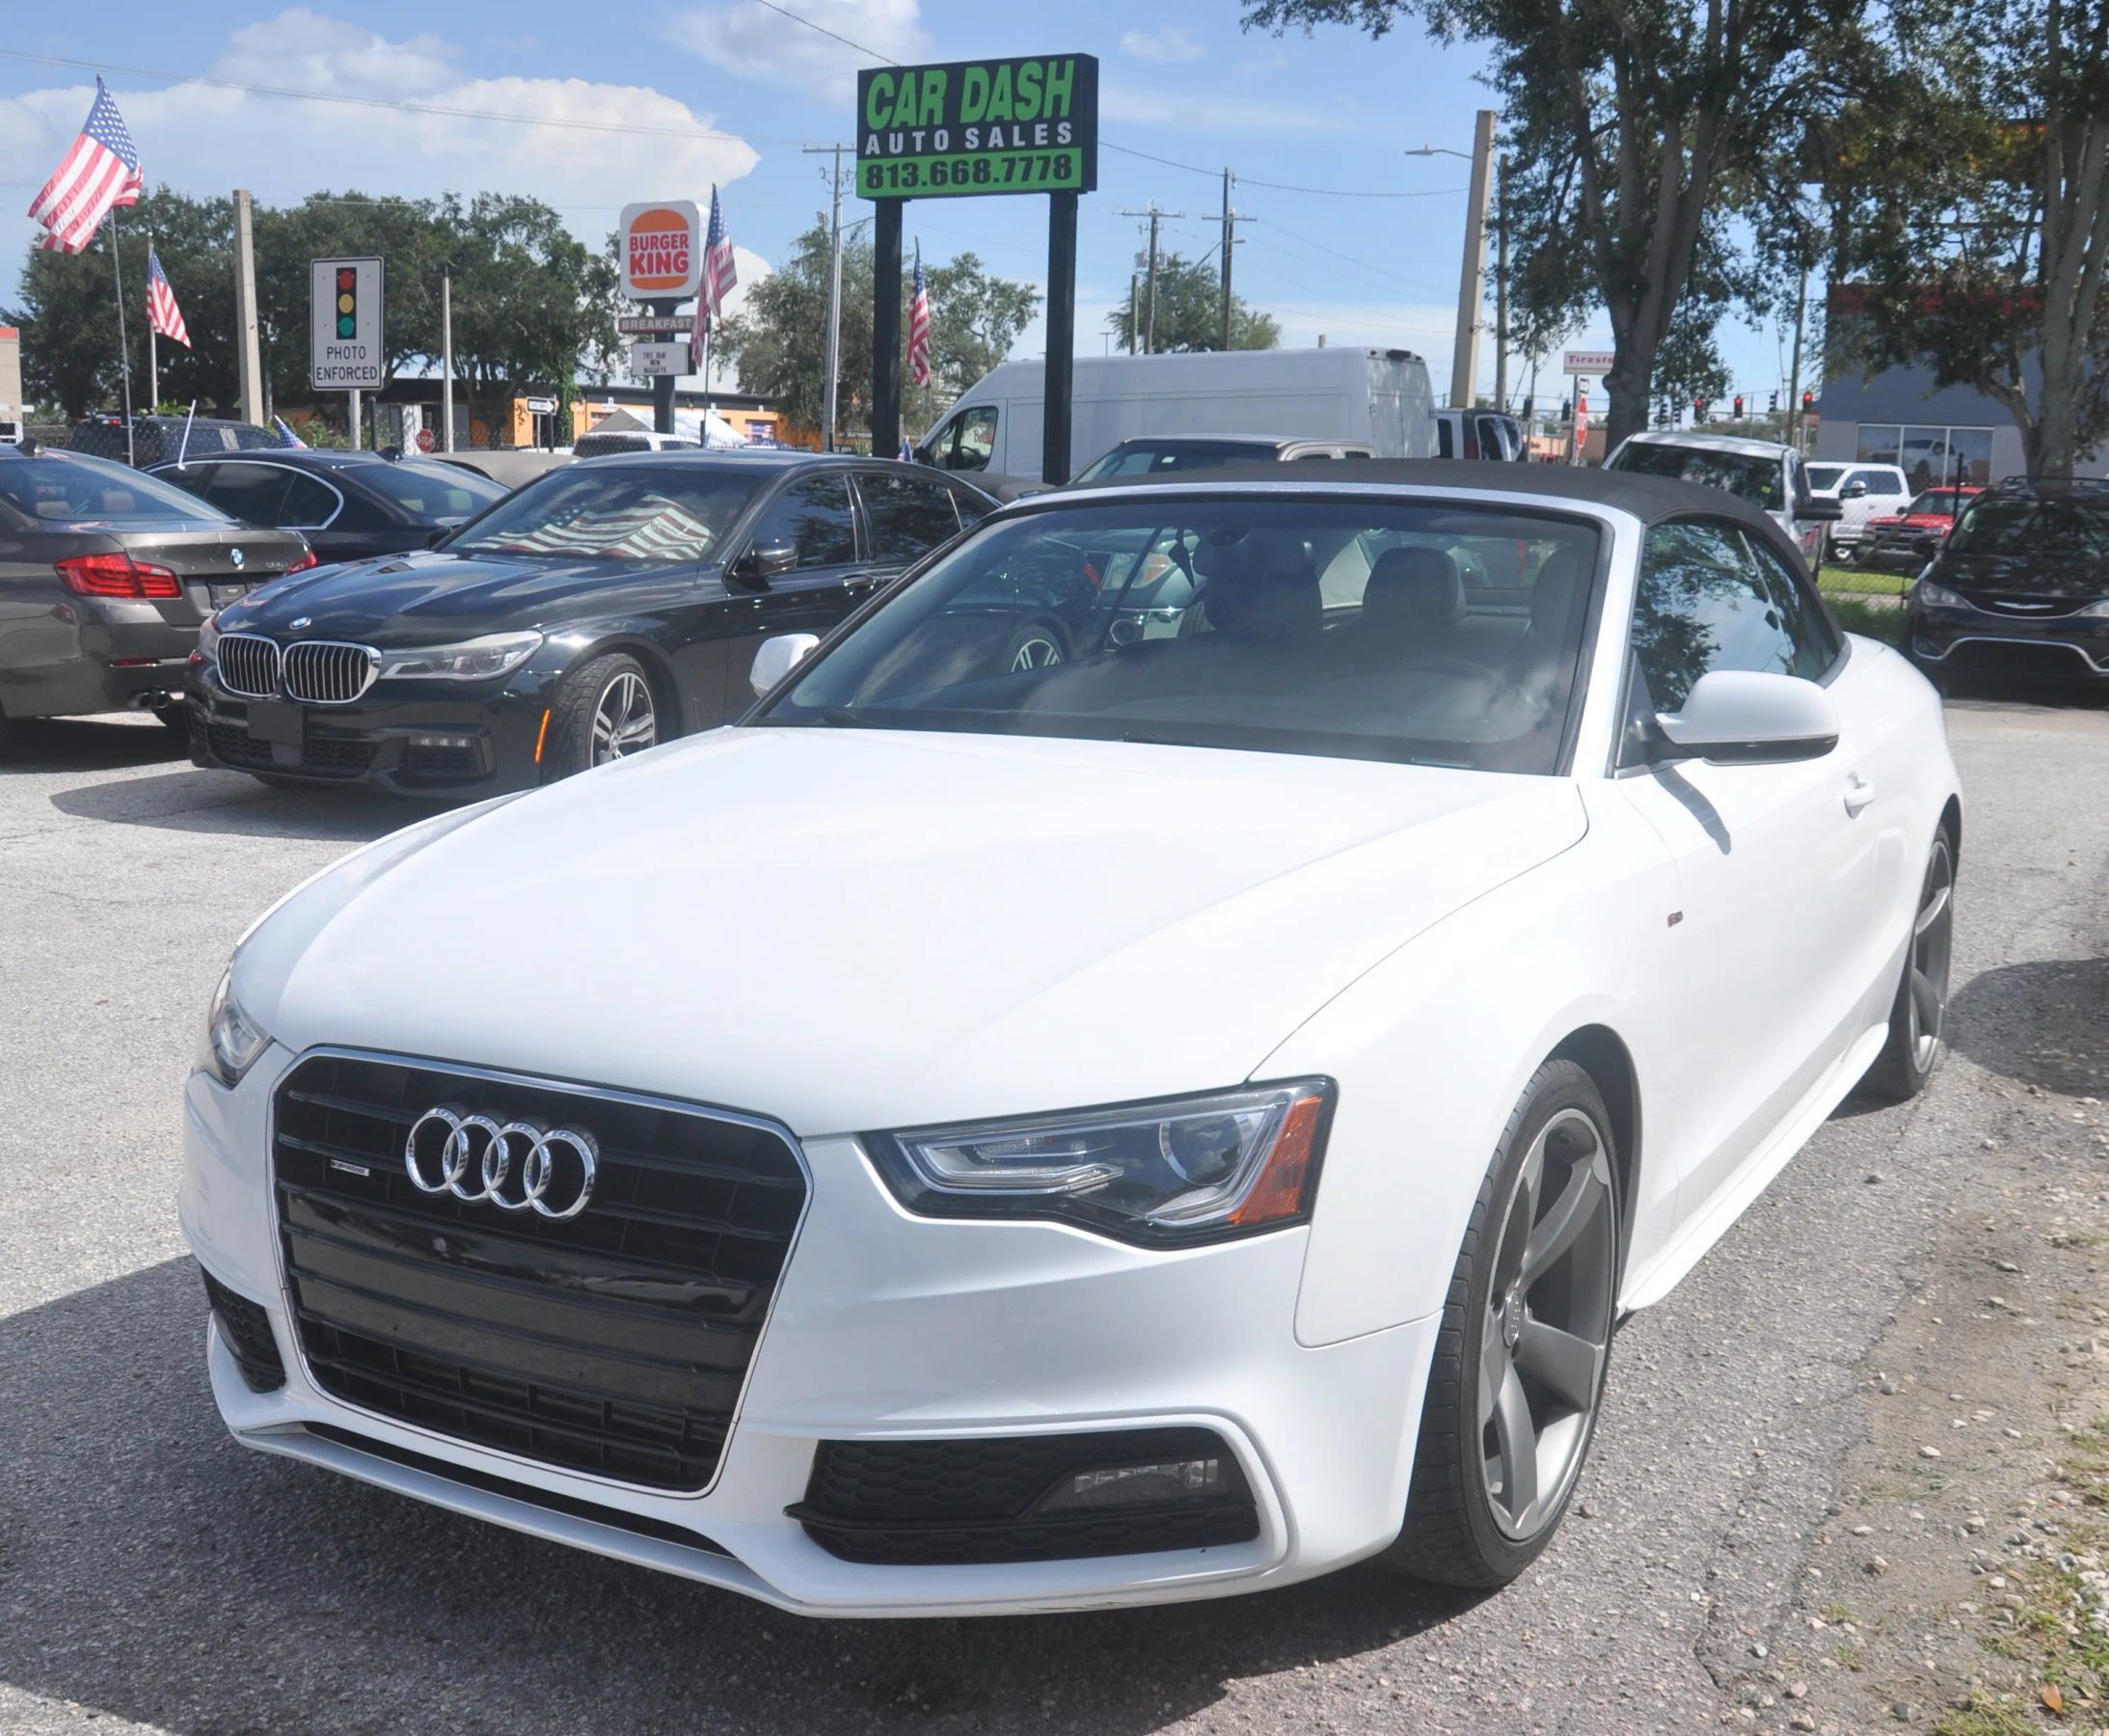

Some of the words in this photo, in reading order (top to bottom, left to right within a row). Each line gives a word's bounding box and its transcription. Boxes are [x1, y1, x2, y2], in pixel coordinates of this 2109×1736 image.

[866, 69, 947, 130] CAR
[960, 60, 1074, 122] DASH
[865, 129, 949, 155] AUTO
[964, 122, 1072, 149] SALES
[865, 153, 1073, 190] 813.668.7778
[630, 233, 689, 251] BURGER
[630, 251, 689, 276] KING
[621, 318, 692, 331] BREAKFAST
[326, 345, 366, 360] PHOTO
[1568, 355, 1615, 365] Firesto
[316, 366, 378, 381] ENFORCED
[416, 435, 433, 445] STOP
